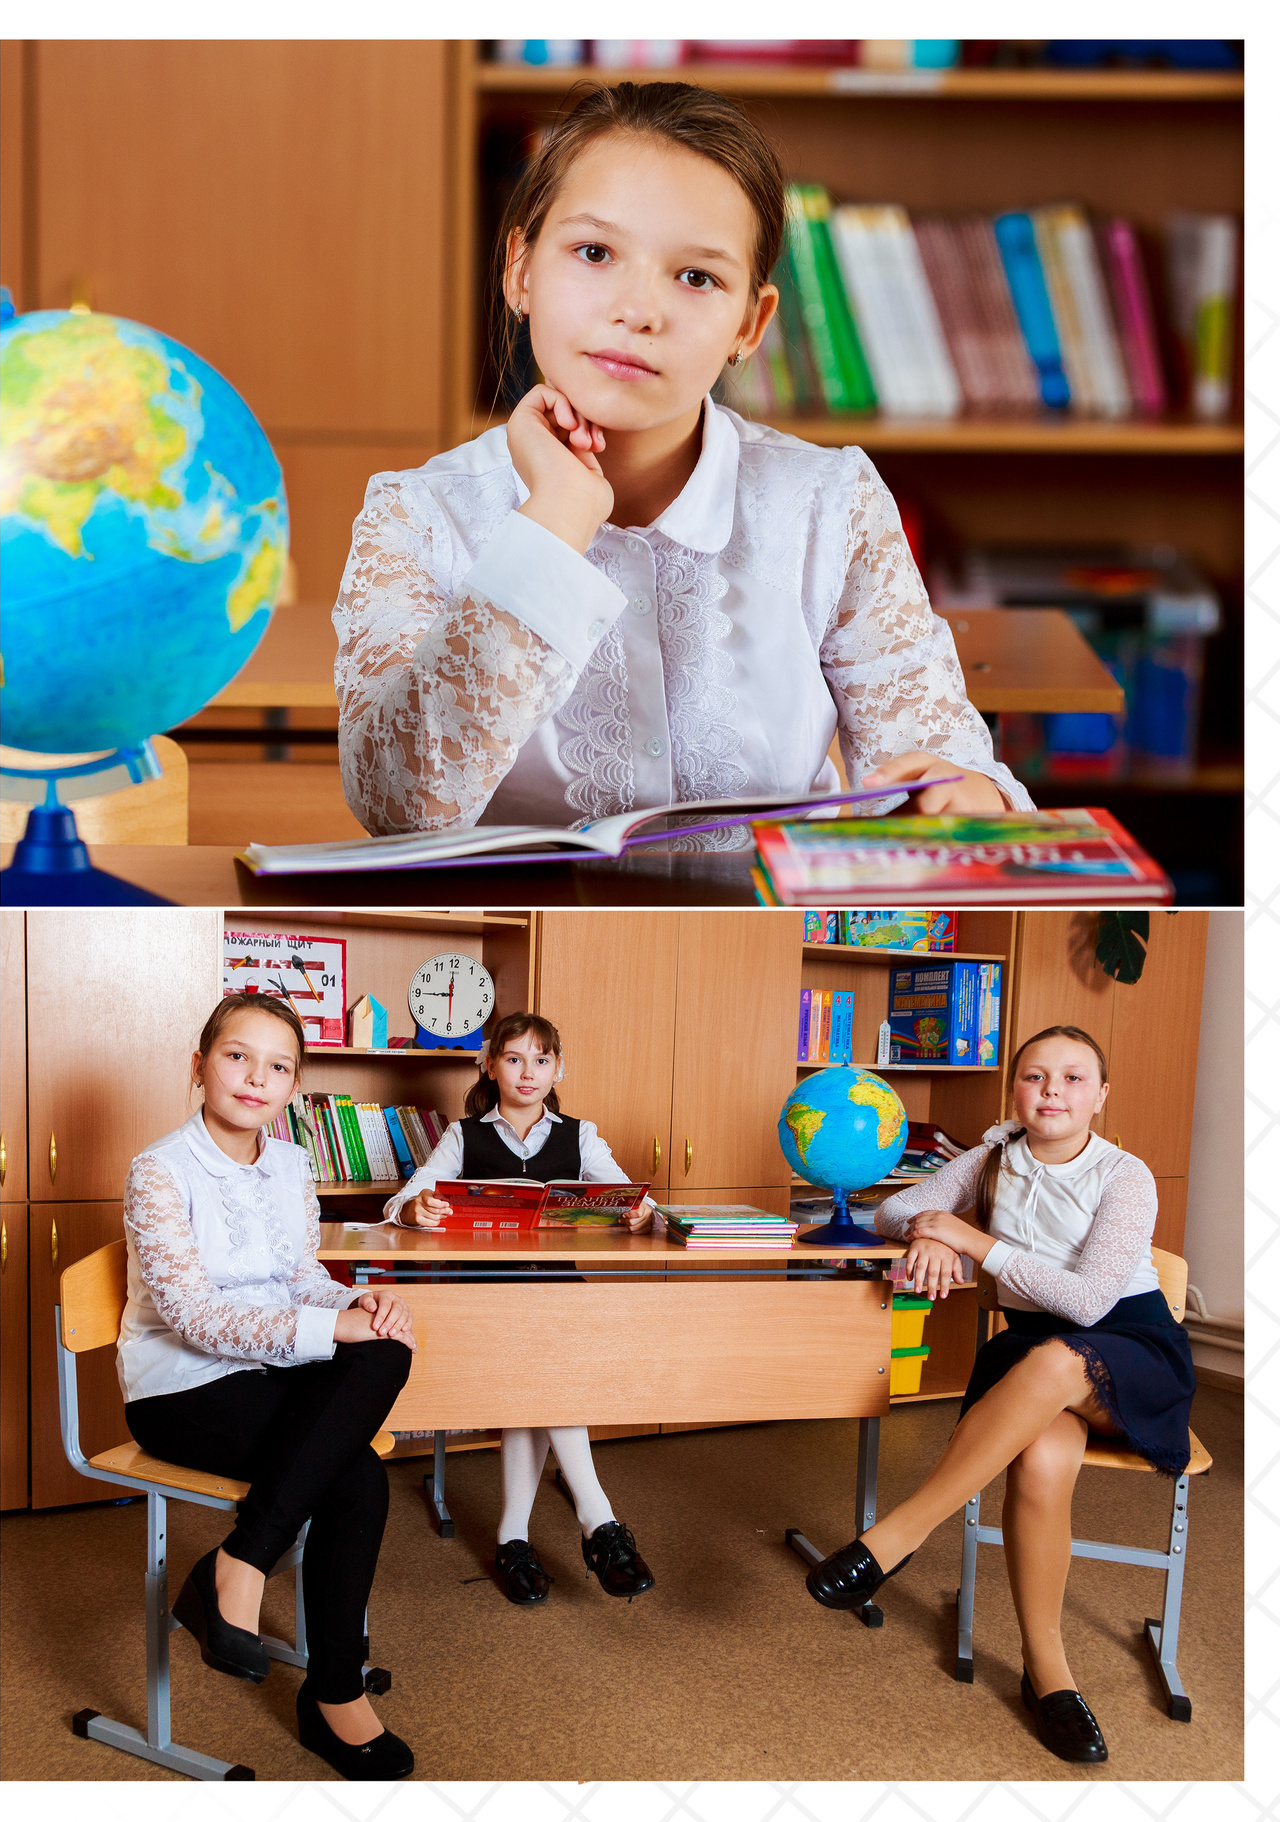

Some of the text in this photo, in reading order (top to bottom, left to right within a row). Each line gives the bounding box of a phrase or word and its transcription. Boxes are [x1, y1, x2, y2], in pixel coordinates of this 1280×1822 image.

[287, 941, 313, 950] ЩИТ
[434, 962, 444, 971] 11
[449, 959, 460, 969] 12
[469, 966, 474, 975] 1
[321, 974, 336, 987] 01
[421, 973, 431, 983] 10
[915, 970, 949, 982] КОМПЛЕКТ
[479, 977, 485, 987] 2
[415, 988, 421, 997] 9
[803, 992, 809, 1000] 4
[482, 994, 488, 1003] 3
[825, 993, 830, 1002] 4
[836, 995, 841, 1004] 4
[846, 996, 851, 1004] 4
[894, 993, 947, 1009] МАТЕМАТИКА
[418, 1005, 424, 1014] 8
[476, 1009, 482, 1018] 4
[431, 1017, 437, 1027] 7
[463, 1020, 469, 1029] 5
[446, 1022, 452, 1032] 6
